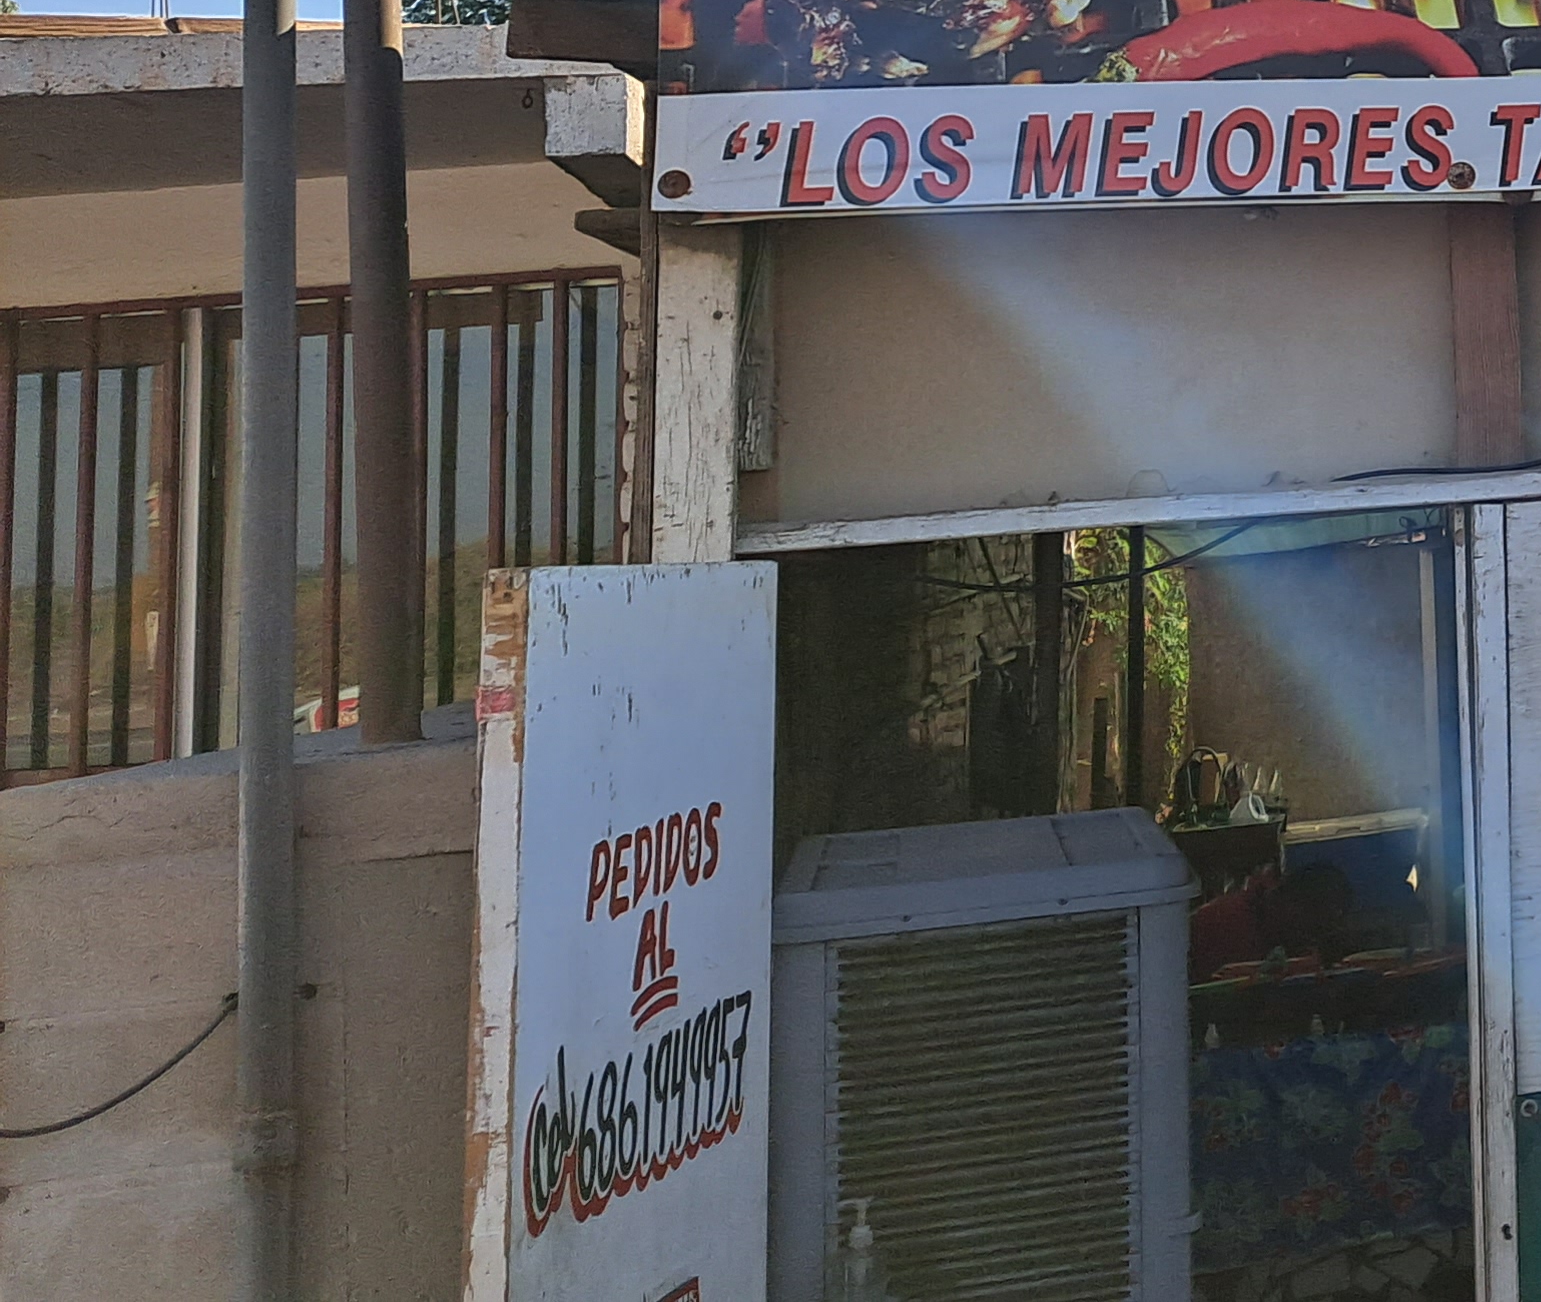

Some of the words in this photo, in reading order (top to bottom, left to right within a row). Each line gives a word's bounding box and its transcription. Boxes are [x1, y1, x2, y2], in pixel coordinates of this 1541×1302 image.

[1010, 103, 1456, 200] MEJORES
[586, 801, 722, 921] PEDIDOS
[632, 901, 677, 991] AL
[576, 990, 753, 1206] 6861949957
